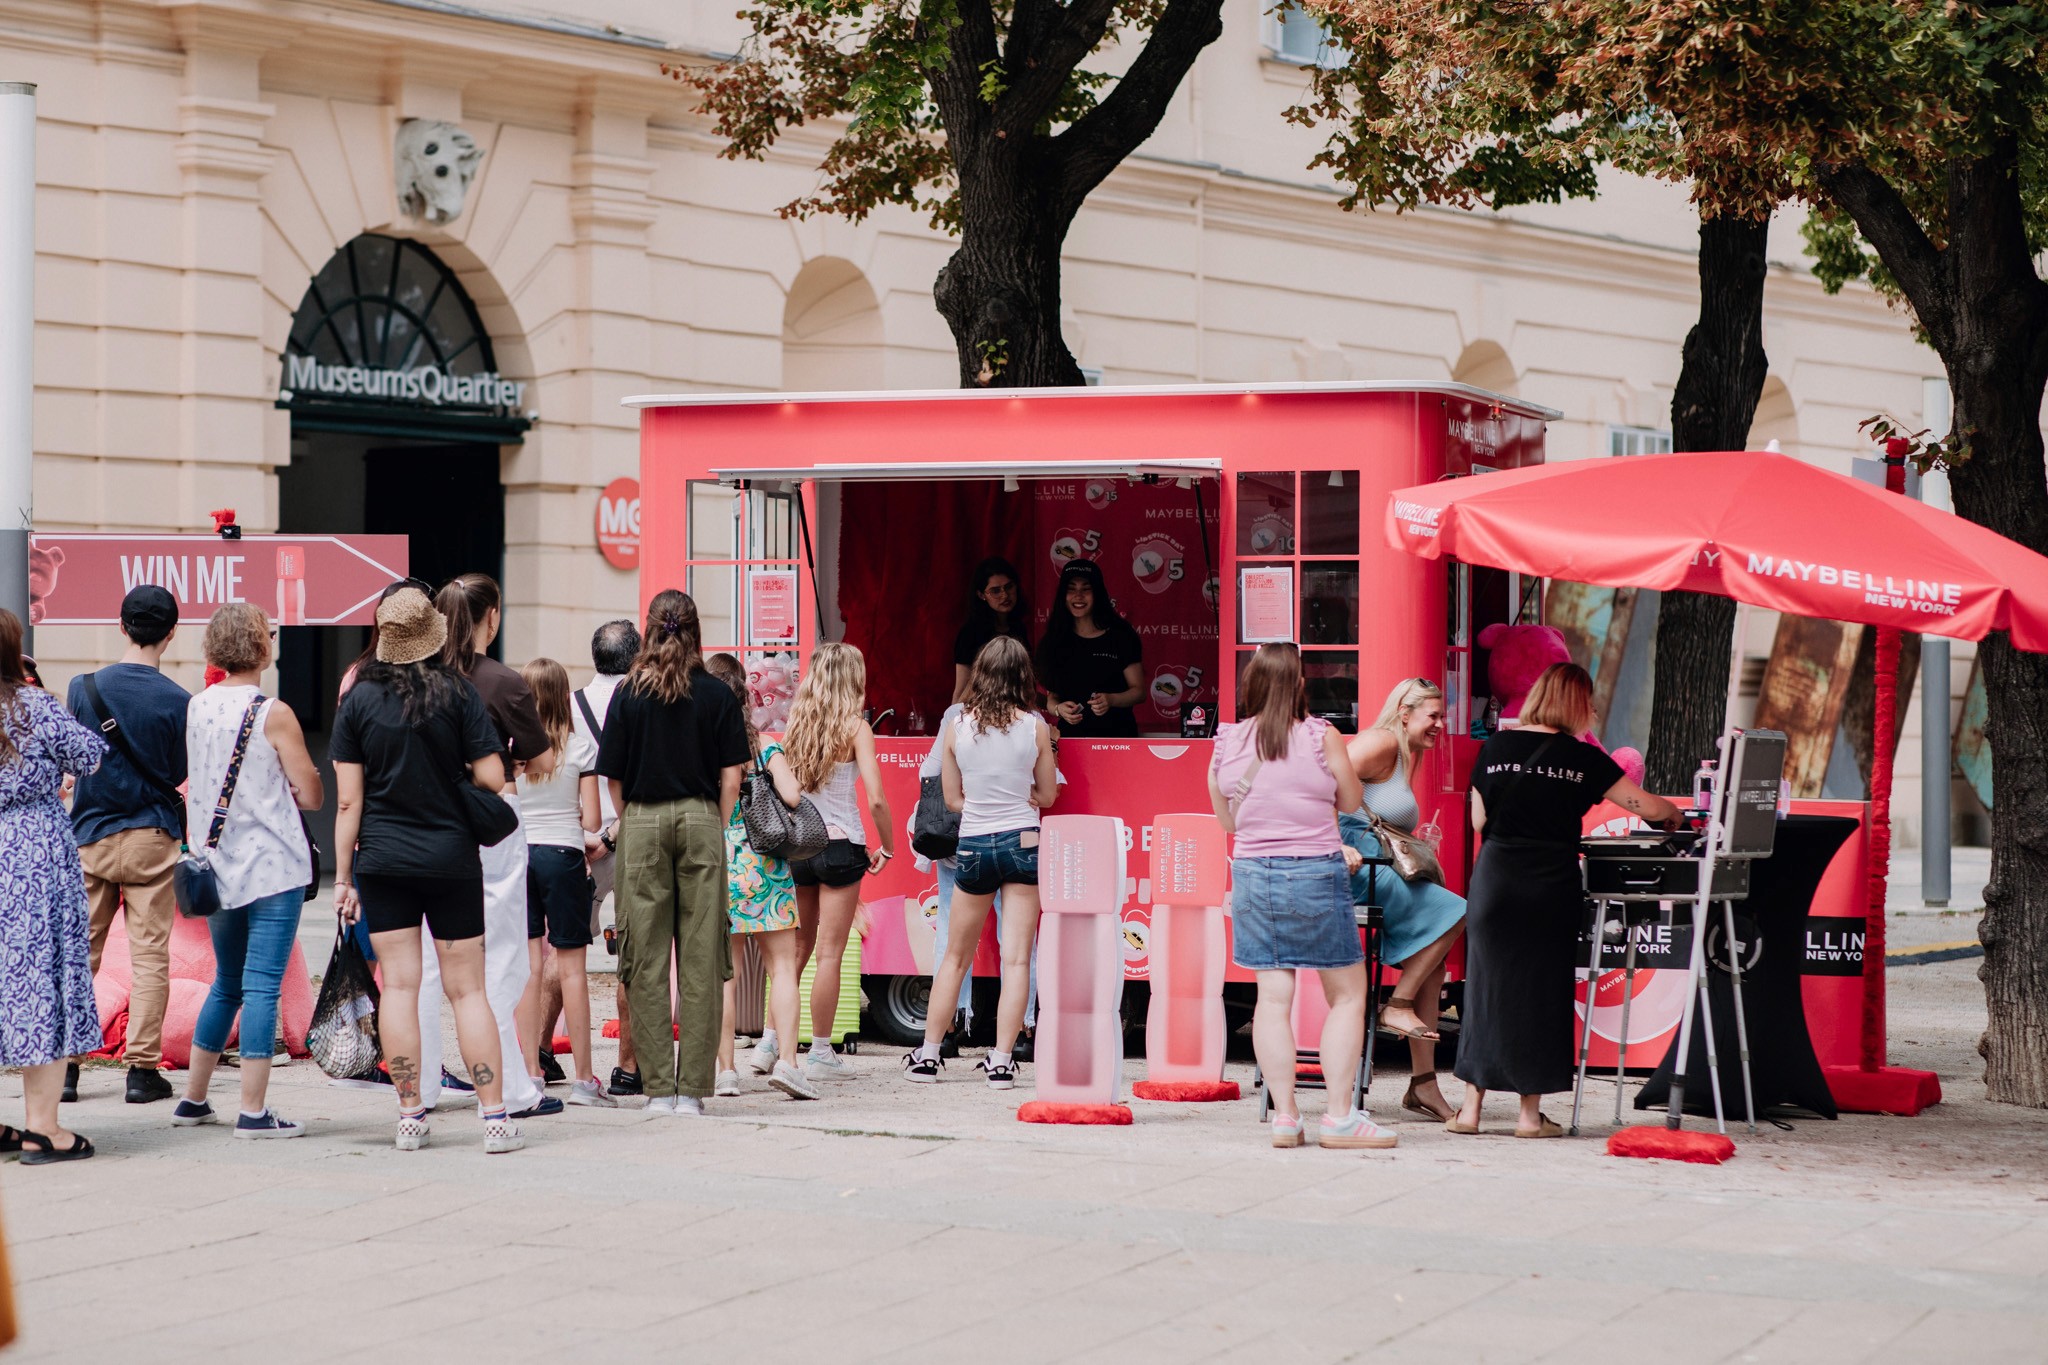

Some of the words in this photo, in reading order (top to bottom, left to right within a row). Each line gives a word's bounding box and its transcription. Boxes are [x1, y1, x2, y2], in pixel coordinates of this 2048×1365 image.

[288, 354, 527, 406] MuseumsQuartier
[1449, 418, 1496, 447] MAYBELLINE
[1082, 529, 1102, 551] 5
[120, 555, 188, 603] WIN
[196, 555, 245, 604] ME
[1168, 559, 1184, 580] 5
[1747, 553, 1962, 605] MAYBELLINE
[1865, 593, 1907, 609] NEW
[1909, 600, 1957, 616] YORK
[1184, 666, 1203, 687] 5
[1174, 840, 1187, 862] STAY
[1187, 838, 1197, 859] TINT
[1174, 863, 1187, 893] SUPER
[1187, 863, 1197, 893] TEDDY
[1806, 950, 1842, 960] NEW
